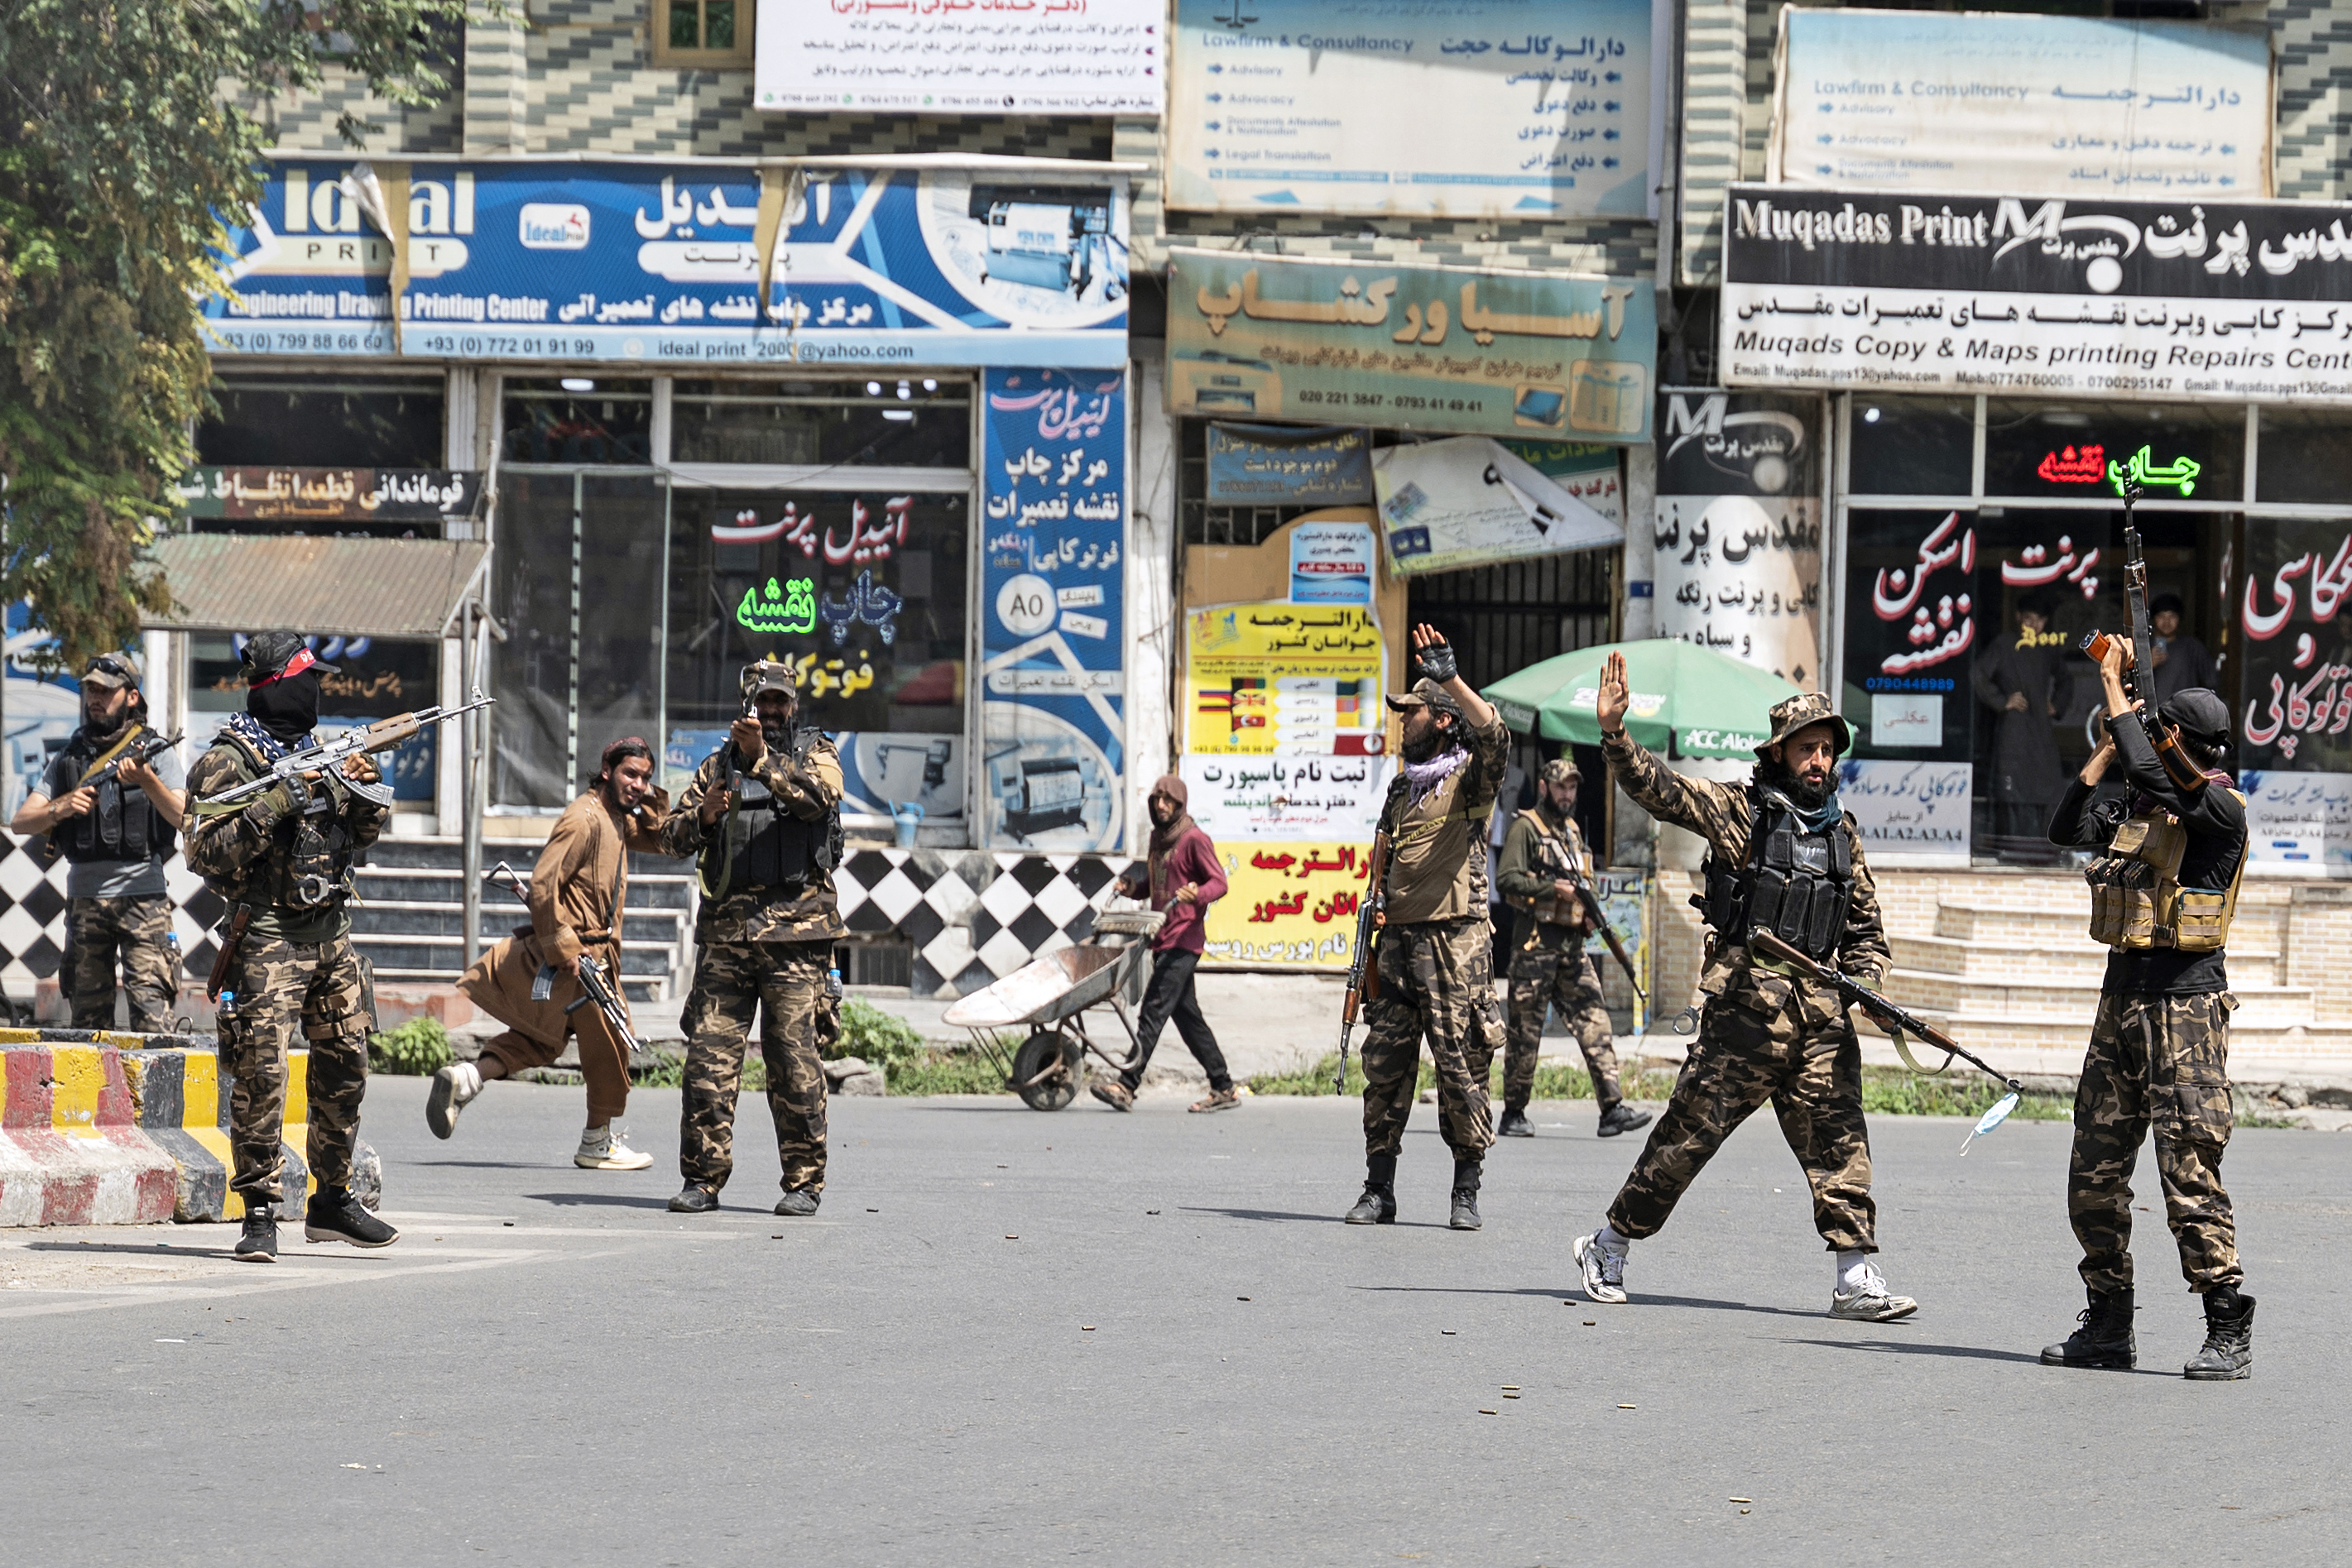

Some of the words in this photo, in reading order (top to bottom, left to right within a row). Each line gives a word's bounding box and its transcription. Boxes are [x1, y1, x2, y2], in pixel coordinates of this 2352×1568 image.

[1202, 32, 1273, 48] Lawfirm
[1279, 35, 1291, 47] &
[1296, 33, 1414, 53] Consultancy
[1228, 65, 1284, 77] Advisory
[1227, 94, 1295, 106] Advocacy
[1814, 79, 1886, 96] Lawfirm
[1891, 81, 1903, 96] &
[1910, 79, 2029, 101] Consultancy
[1839, 103, 1895, 115] Advisory
[284, 168, 476, 236] Idal
[526, 221, 566, 242] Ideal
[1734, 198, 1893, 252] Muqadas
[1899, 204, 1990, 248] Print
[306, 242, 442, 262] PRIT
[2143, 204, 2252, 278] پرنت
[338, 290, 411, 320] Drawig
[414, 292, 485, 321] Printing
[487, 293, 550, 320] Center
[660, 295, 704, 324] های
[708, 295, 759, 321] نقشه
[816, 296, 874, 325] مرکز
[1737, 293, 1836, 320] مقدس
[1950, 297, 2019, 328] های
[2027, 300, 2128, 327] نقشه
[2291, 308, 2352, 341] رکز
[250, 332, 272, 352] (0)
[277, 332, 307, 348] 799
[313, 333, 332, 348] 88
[338, 333, 358, 349] 66
[424, 336, 454, 352] +93
[459, 335, 482, 354] (0)
[487, 337, 517, 352] 772
[522, 338, 543, 353] 01
[548, 338, 569, 354] 91
[574, 339, 595, 355] 99
[658, 339, 700, 357] ideal
[1734, 331, 1844, 357] Muqads
[1855, 334, 1927, 362] Copy
[1937, 337, 1955, 357] &
[1965, 338, 2039, 366] Maps
[2047, 343, 2158, 371] printing
[2167, 344, 2275, 371] Repairs
[2286, 348, 2352, 370] Cent
[1004, 445, 1053, 487] چاپ
[1056, 447, 1110, 487] مرکز
[2037, 444, 2106, 483] نقشه
[986, 488, 1070, 528] تعمیرات
[1073, 491, 1121, 521] نقشه
[710, 500, 818, 559] پرنت
[1871, 509, 1977, 621] اسکن
[2000, 534, 2100, 601] پرنت
[736, 576, 817, 635] نقشه
[1718, 580, 1764, 616] پرنت
[2292, 631, 2316, 669] و
[1684, 729, 1721, 750] ACC
[1203, 760, 1287, 790] پاسپورت
[1294, 760, 1322, 788] نام
[1329, 756, 1366, 789] ثبت
[1284, 794, 1322, 808] خدما
[1248, 891, 1308, 923] کشور
